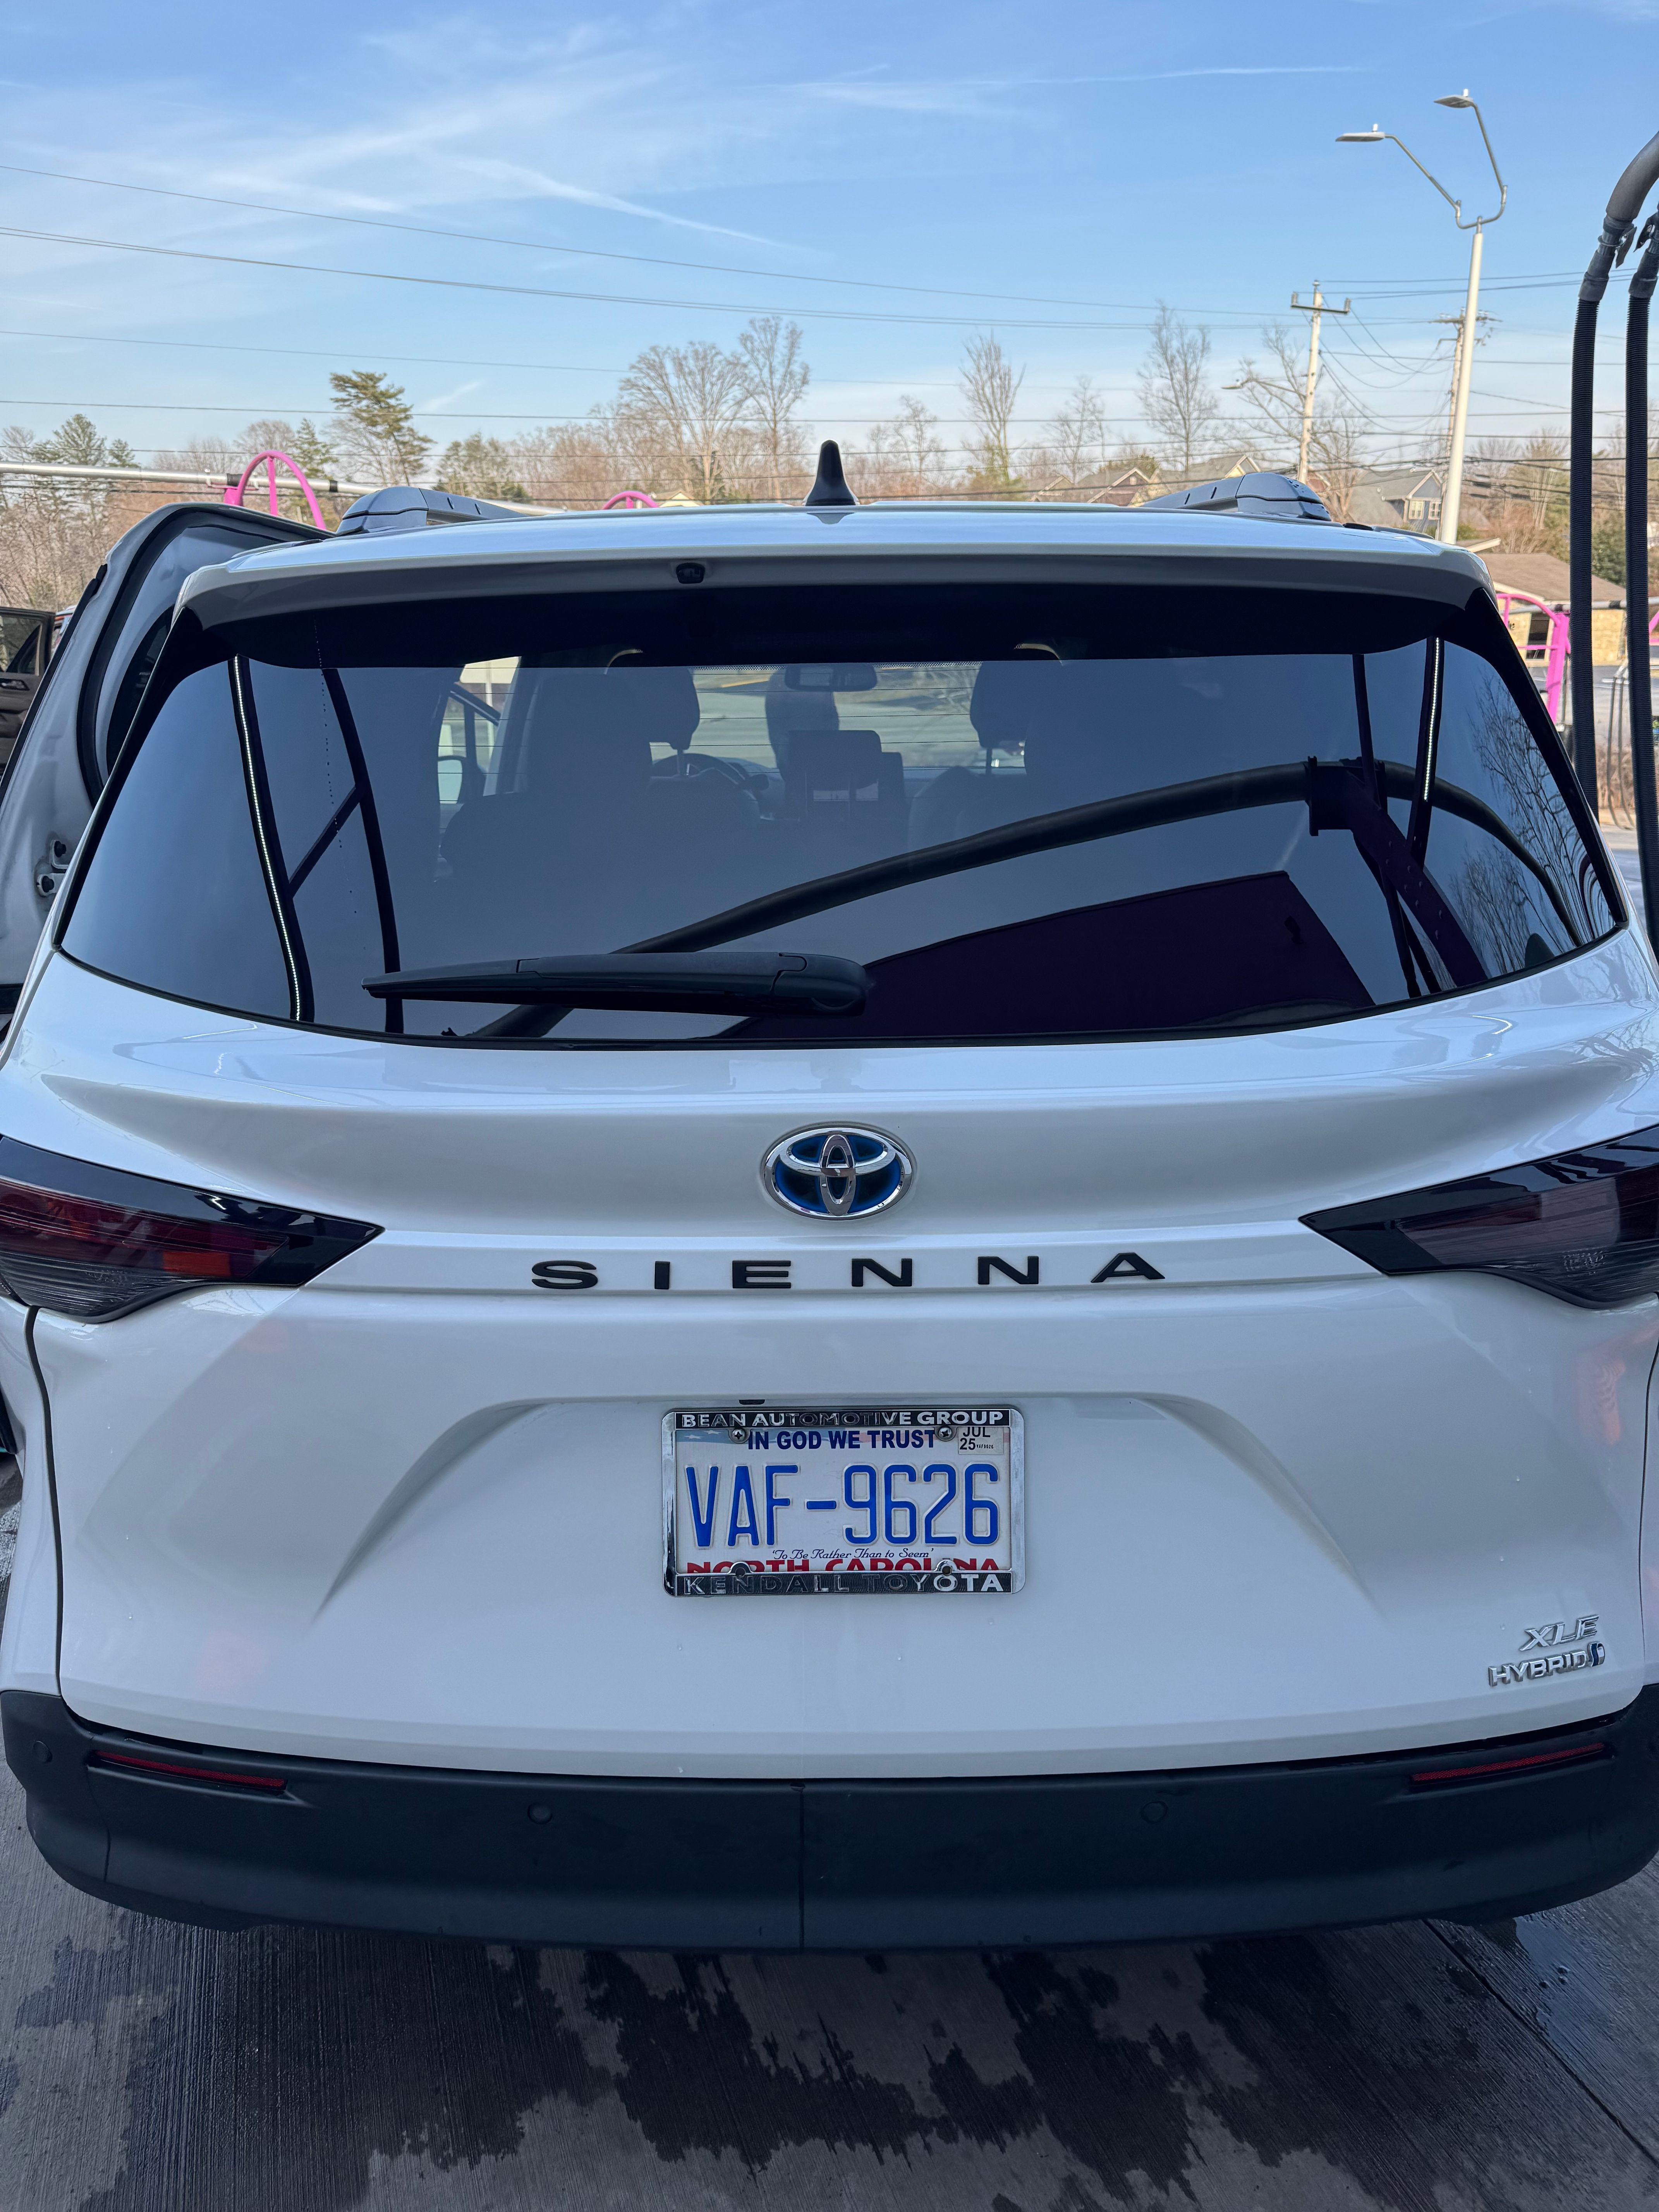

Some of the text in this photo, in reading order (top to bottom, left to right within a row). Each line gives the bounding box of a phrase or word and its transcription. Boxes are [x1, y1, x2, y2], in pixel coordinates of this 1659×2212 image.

[532, 1252, 1166, 1290] SIENNA
[682, 1411, 1003, 1427] BEAN AUTOMOTIVE GROUP
[748, 1430, 936, 1450] IN GOD WE TRUST
[963, 1427, 991, 1437] JUL
[959, 1438, 976, 1450] 25
[686, 1463, 998, 1547] VAF-9626
[790, 1549, 809, 1559] Be
[811, 1548, 852, 1559] Rather
[854, 1548, 882, 1558] Than
[825, 1558, 1000, 1571] CAROLNA
[684, 1573, 1004, 1595] KENDALL TOYOTA
[1519, 1614, 1600, 1651] XLE
[1488, 1650, 1588, 1687] HYBRID
